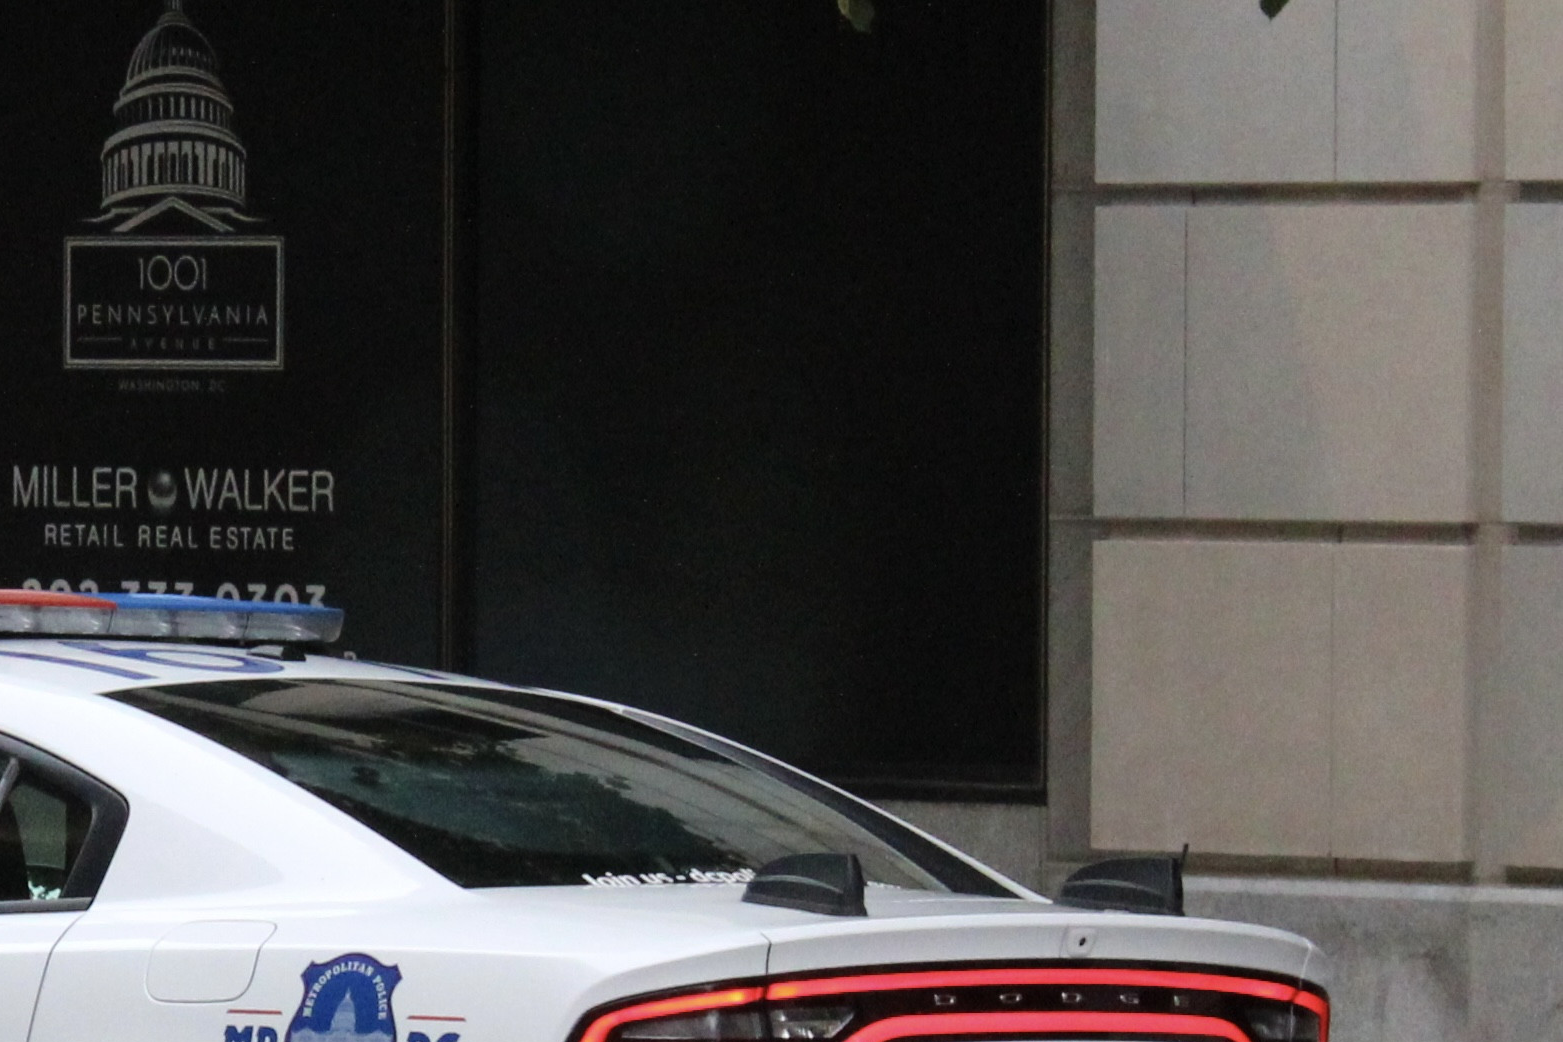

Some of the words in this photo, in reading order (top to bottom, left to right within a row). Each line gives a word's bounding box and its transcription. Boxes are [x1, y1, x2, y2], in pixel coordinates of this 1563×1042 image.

[138, 255, 207, 291] 1001
[77, 304, 268, 325] PENNSYLVANIA
[131, 337, 216, 350] AVENUE
[12, 465, 137, 508] MILLER
[184, 467, 334, 512] WALKER
[44, 523, 124, 548] RETAIL
[137, 525, 198, 549] REAL
[210, 526, 294, 550] ESTATE
[581, 871, 642, 887] Join
[639, 872, 674, 884] us
[302, 960, 375, 1018] METROPOLITAN
[372, 974, 388, 1020] POLICE
